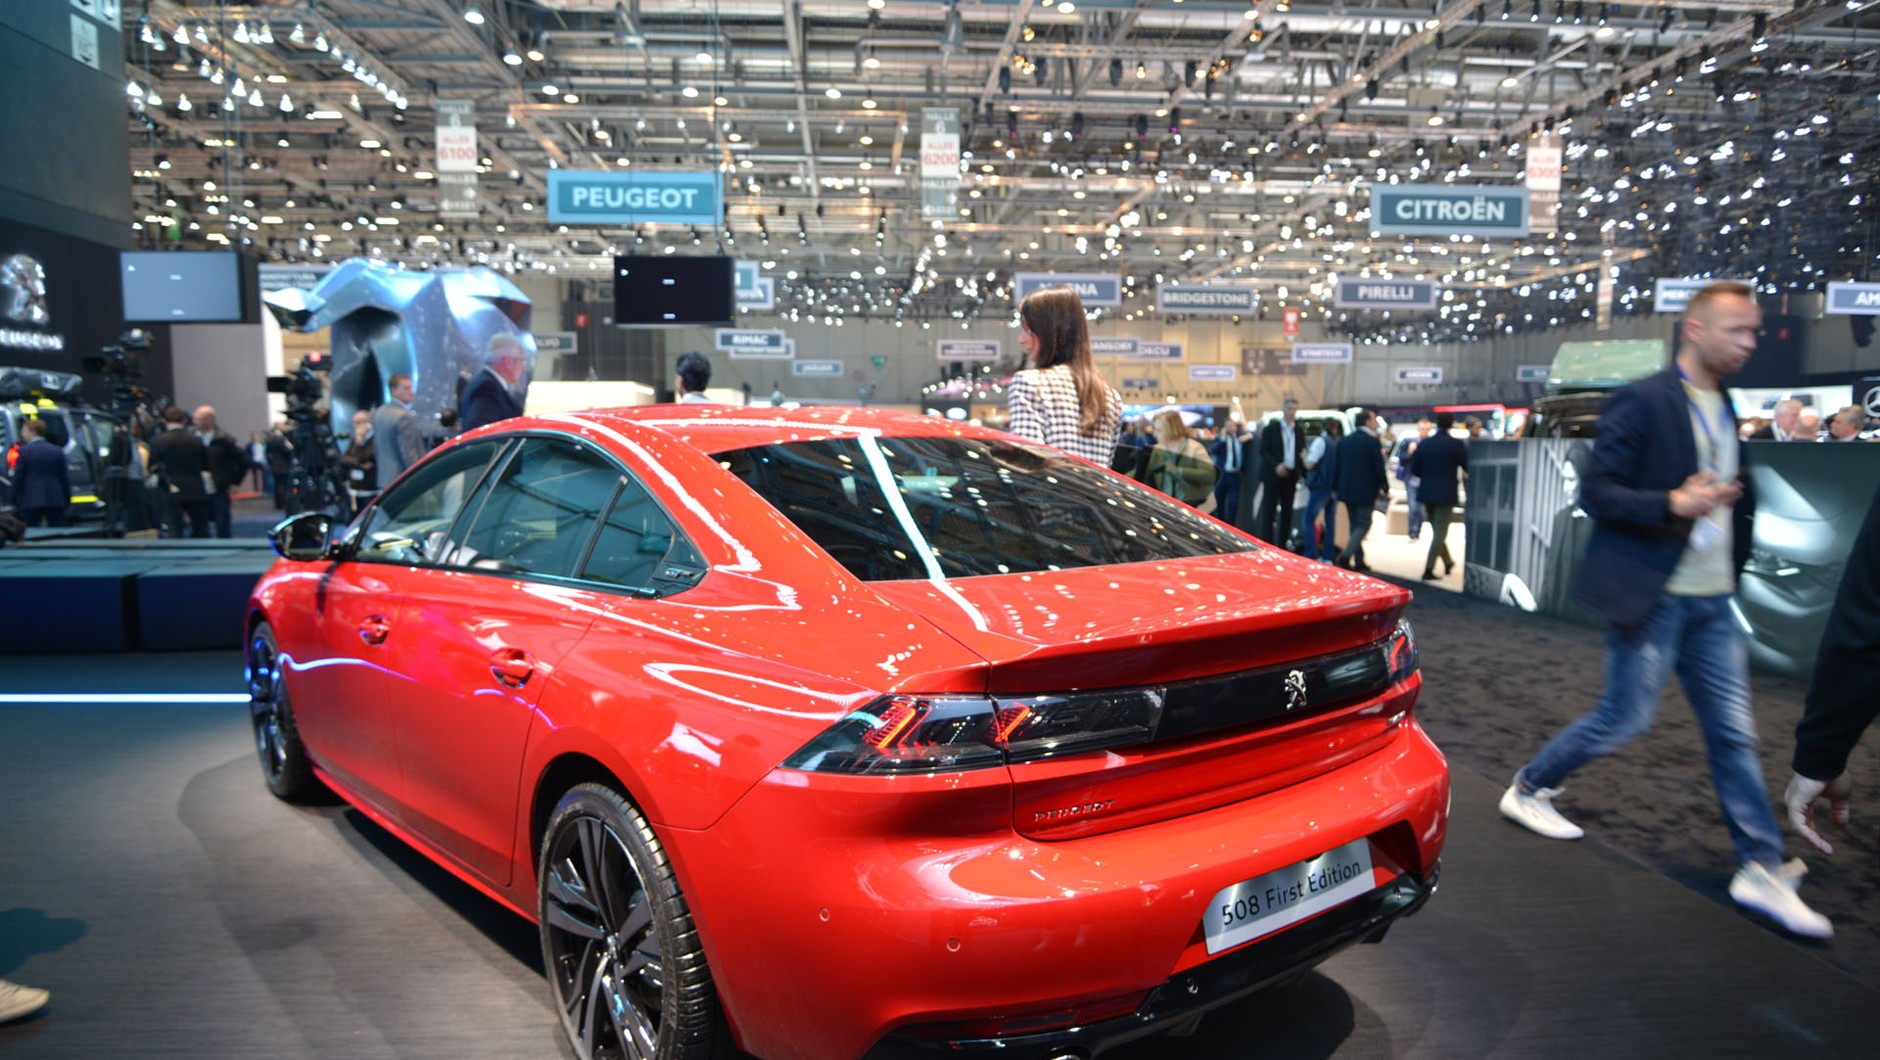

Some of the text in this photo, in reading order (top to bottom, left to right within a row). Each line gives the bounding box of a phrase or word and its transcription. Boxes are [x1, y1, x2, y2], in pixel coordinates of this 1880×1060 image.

[439, 147, 475, 159] 6100
[923, 153, 959, 165] 6200
[572, 186, 699, 209] PEUGEOT
[1395, 195, 1505, 221] CITROËN
[1163, 291, 1249, 306] BRIDGESTONE
[1357, 285, 1414, 300] PIRELLI
[731, 334, 769, 346] RIMAC
[1222, 861, 1362, 926] 508 First Edition
